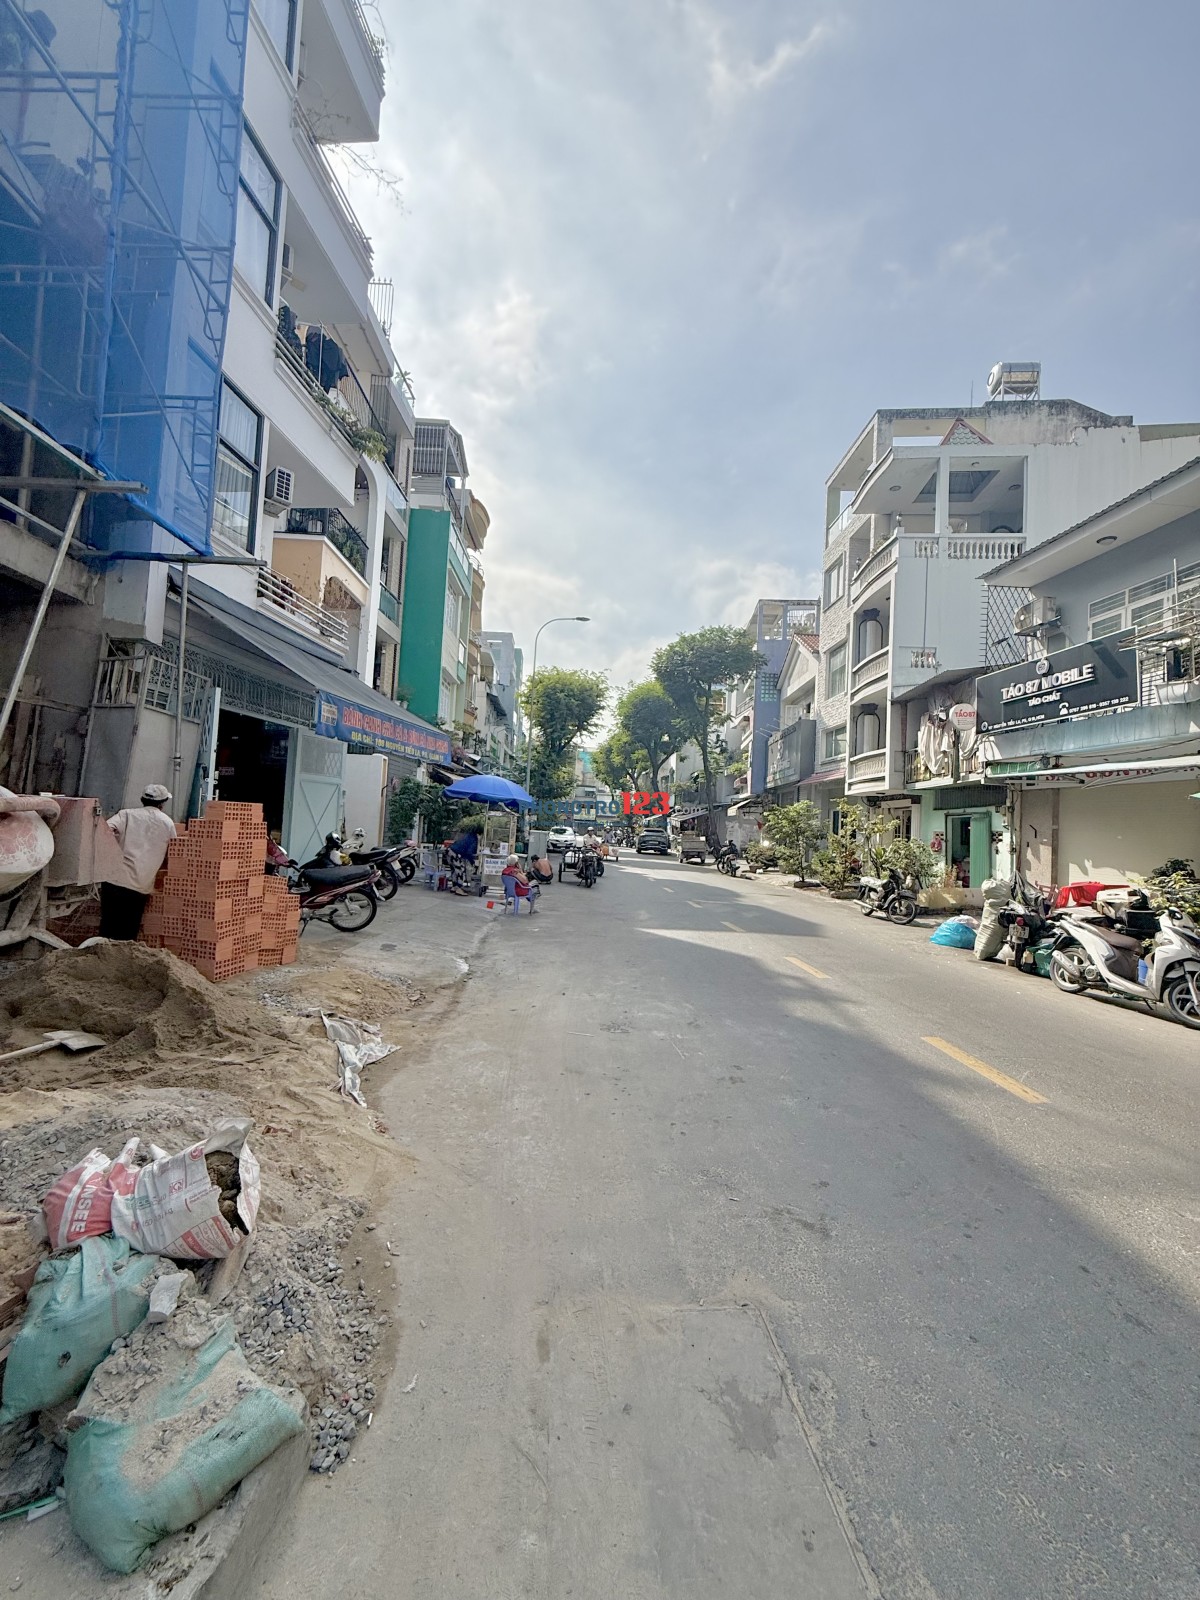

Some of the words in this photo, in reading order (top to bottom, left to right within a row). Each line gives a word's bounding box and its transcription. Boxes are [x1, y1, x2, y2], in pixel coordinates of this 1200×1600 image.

[1001, 682, 1024, 700] TÁO
[1025, 680, 1039, 694] 87
[1041, 664, 1095, 689] MOBILE
[342, 705, 363, 729] BÁNH
[363, 713, 382, 734] CANH
